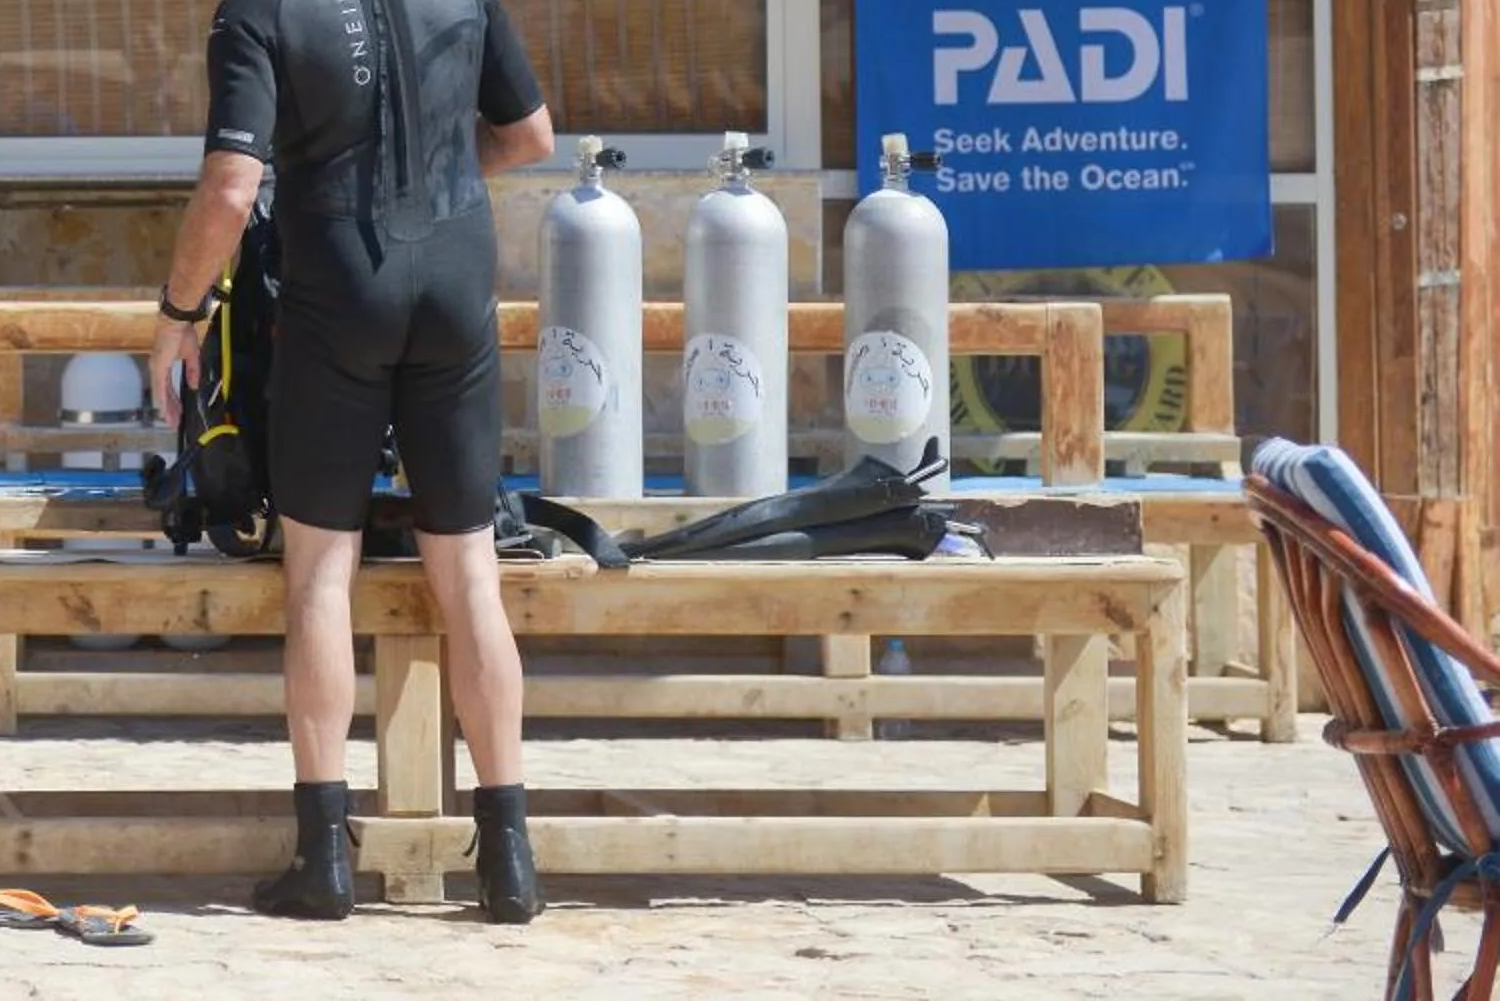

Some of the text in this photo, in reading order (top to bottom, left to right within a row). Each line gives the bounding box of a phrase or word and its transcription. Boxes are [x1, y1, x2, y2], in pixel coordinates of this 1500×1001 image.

[933, 6, 1189, 105] PADI
[934, 125, 1188, 154] Seek Adventure.
[935, 163, 1188, 192] Save the Ocean.
